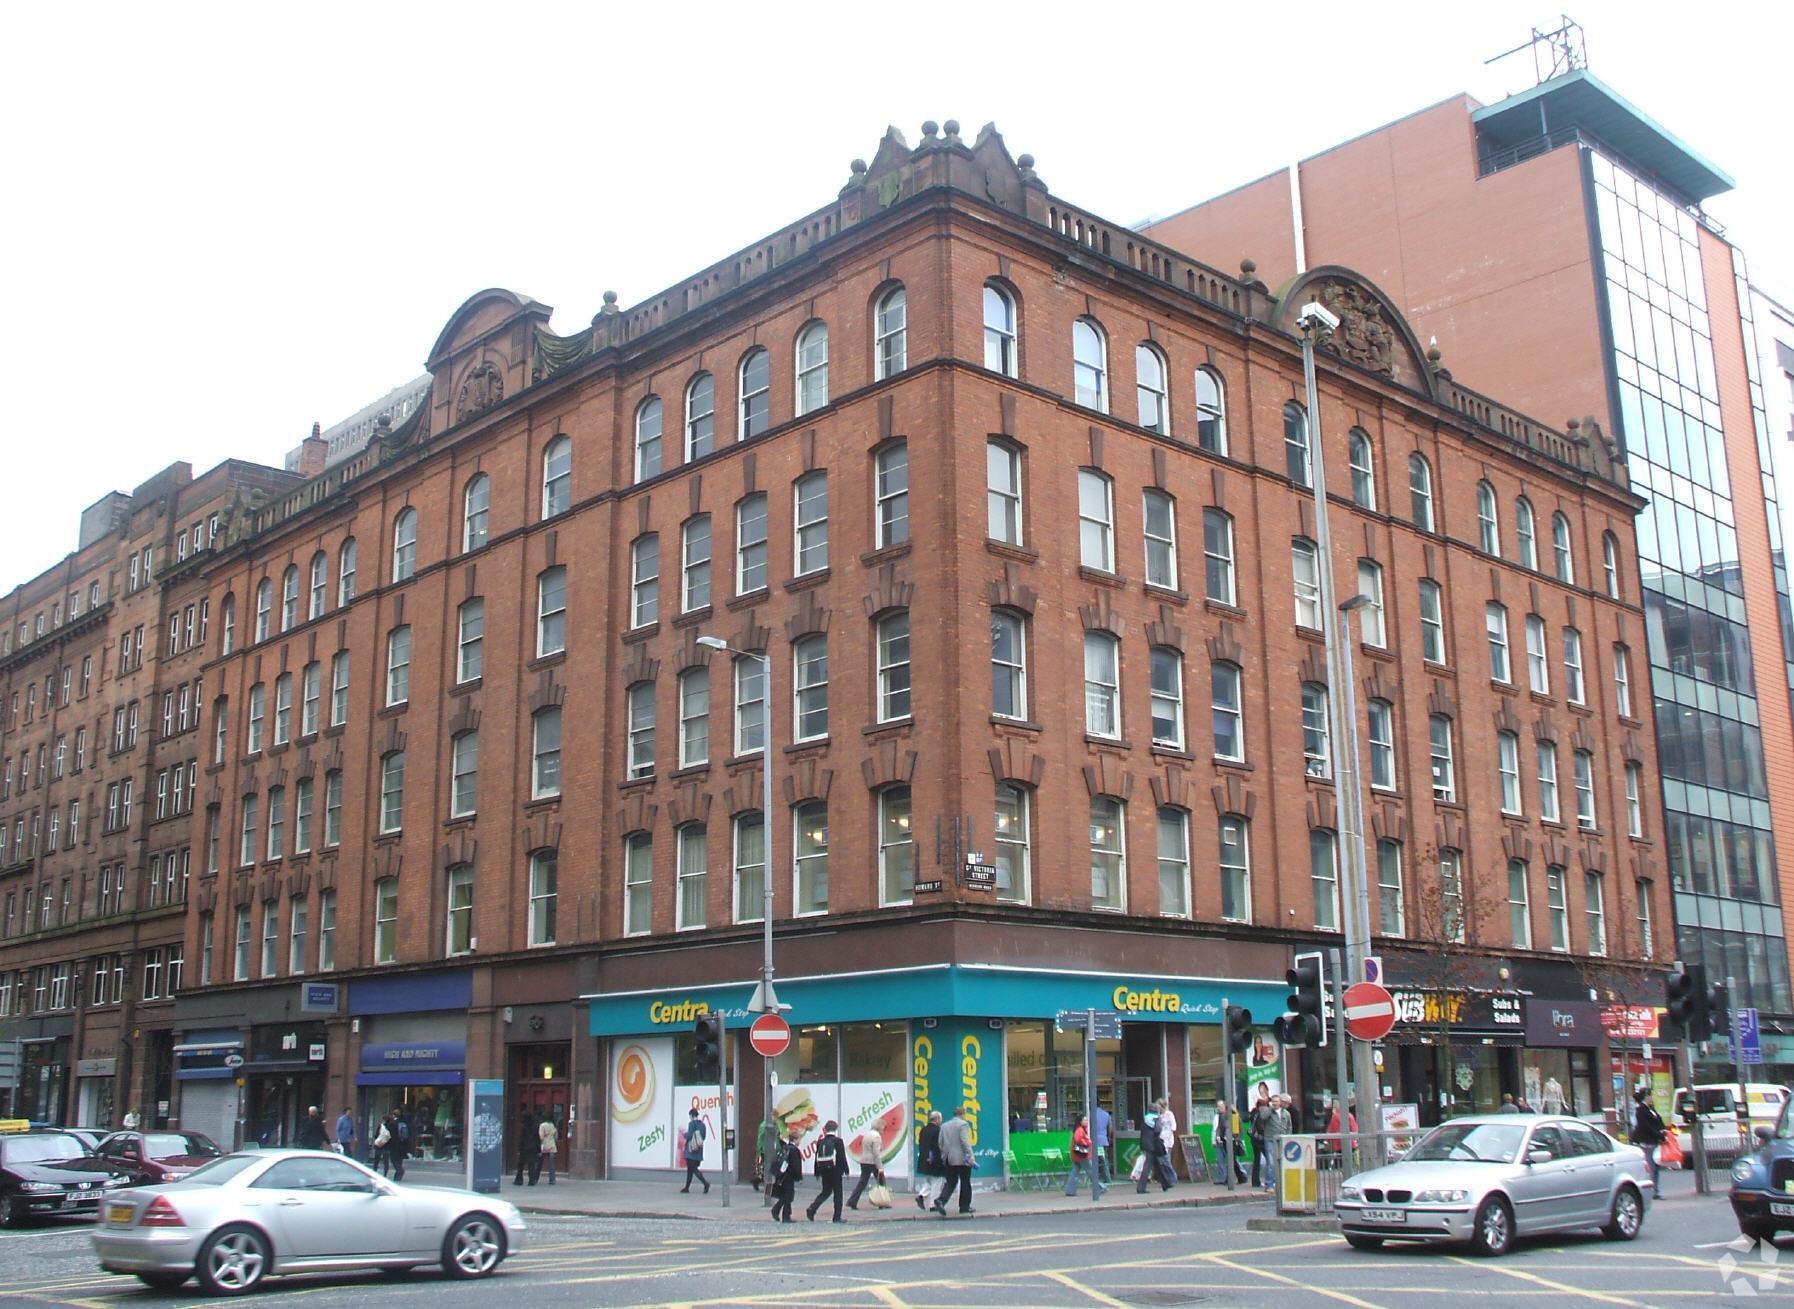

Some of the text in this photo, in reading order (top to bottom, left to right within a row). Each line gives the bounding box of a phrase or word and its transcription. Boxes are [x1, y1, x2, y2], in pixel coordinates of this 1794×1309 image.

[972, 872, 989, 880] STREET
[974, 865, 995, 874] VICTORIA
[1113, 986, 1181, 1013] Centra
[1203, 1003, 1219, 1015] Stop
[1492, 998, 1520, 1010] Subs &
[650, 1000, 709, 1024] Centra
[1494, 1012, 1520, 1024] Salads
[692, 1091, 734, 1111] Quenh
[847, 1091, 894, 1133] Refresh
[637, 1124, 666, 1153] Zesty
